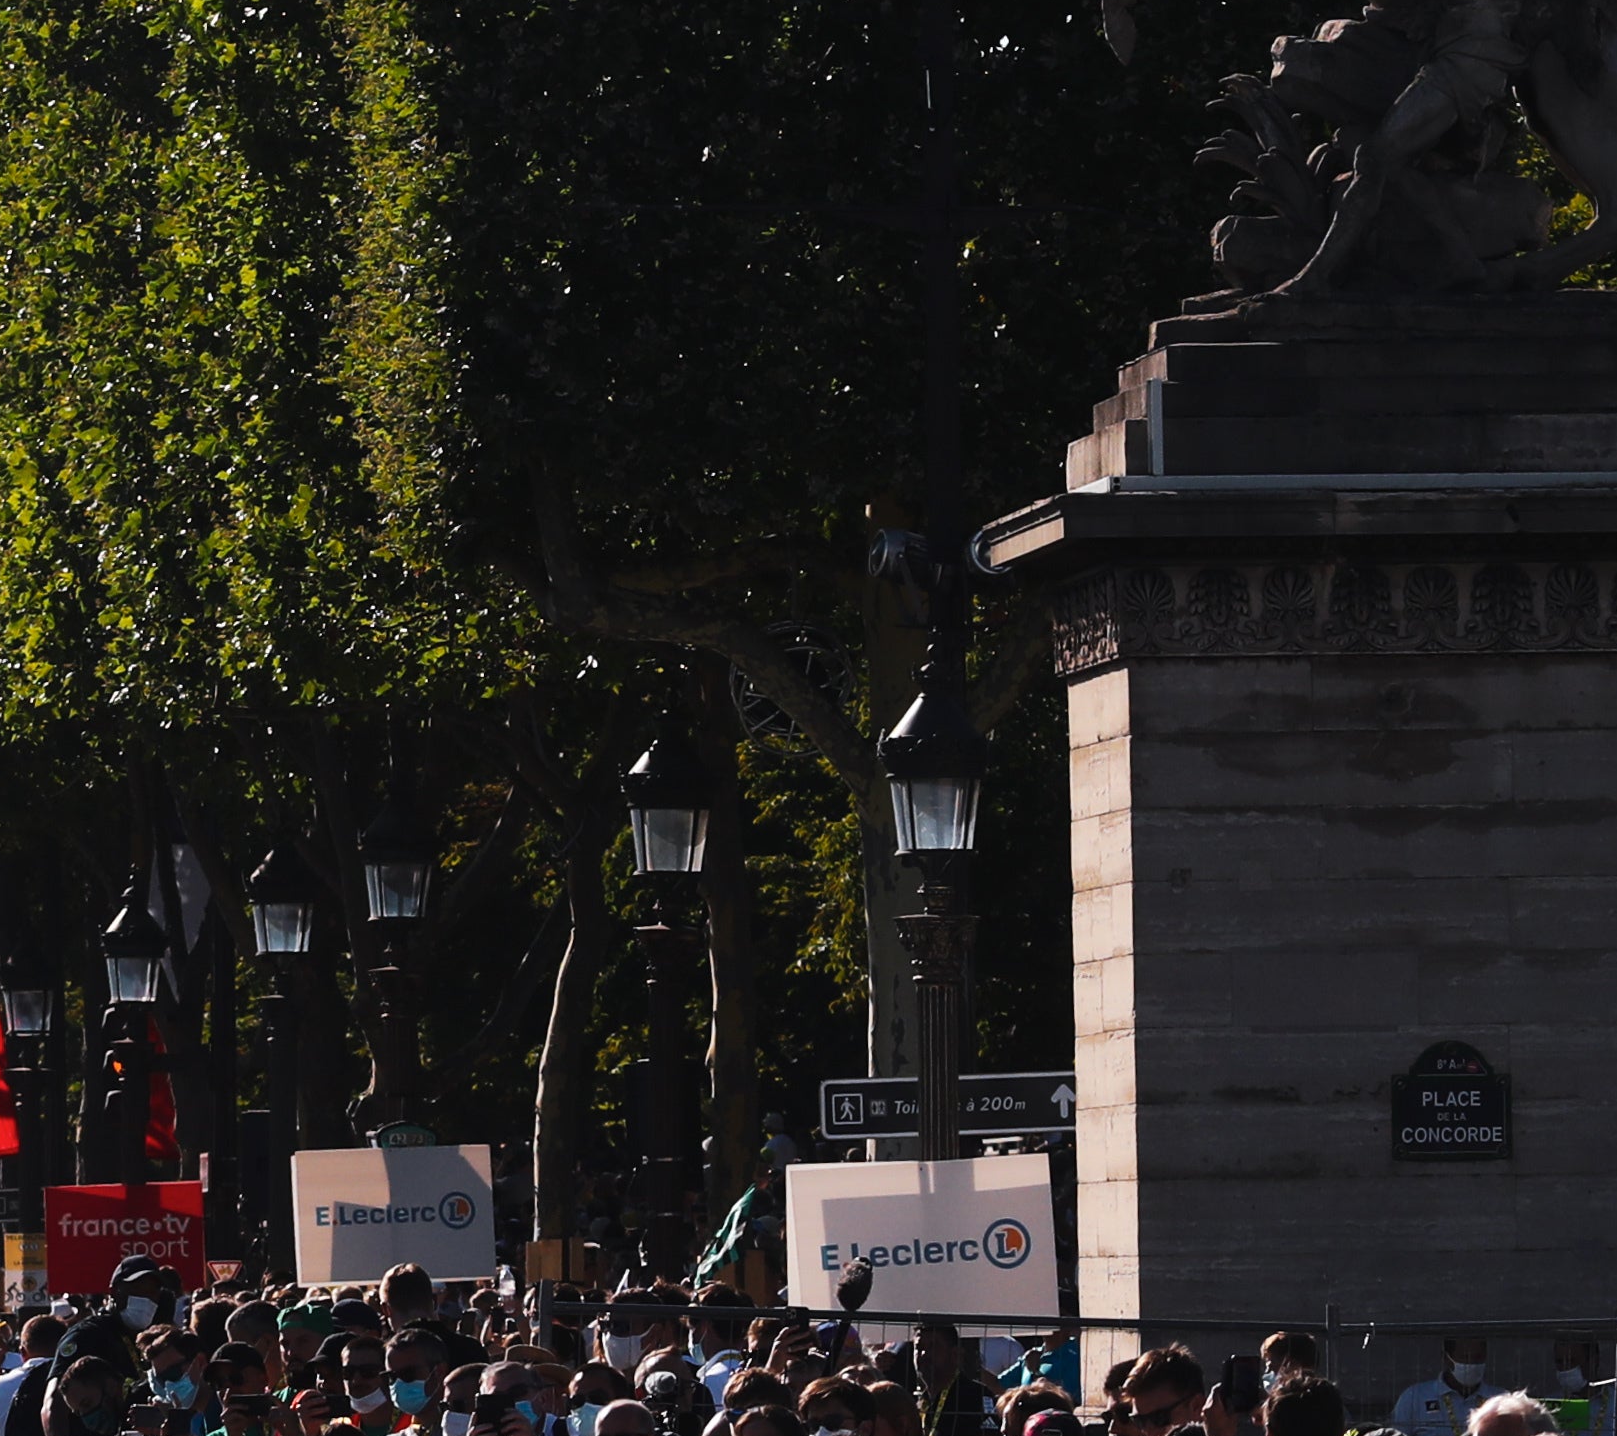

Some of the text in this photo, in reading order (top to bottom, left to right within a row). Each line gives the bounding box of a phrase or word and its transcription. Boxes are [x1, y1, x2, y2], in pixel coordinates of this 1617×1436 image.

[965, 1095, 1027, 1112] à 200m
[1421, 1090, 1482, 1107] PLACE
[1436, 1112, 1467, 1122] DE LA
[1401, 1126, 1503, 1144] CONCORDE
[315, 1203, 436, 1227] E.Leclerc
[119, 1236, 190, 1260] sport
[821, 1239, 979, 1271] ELeclerc
